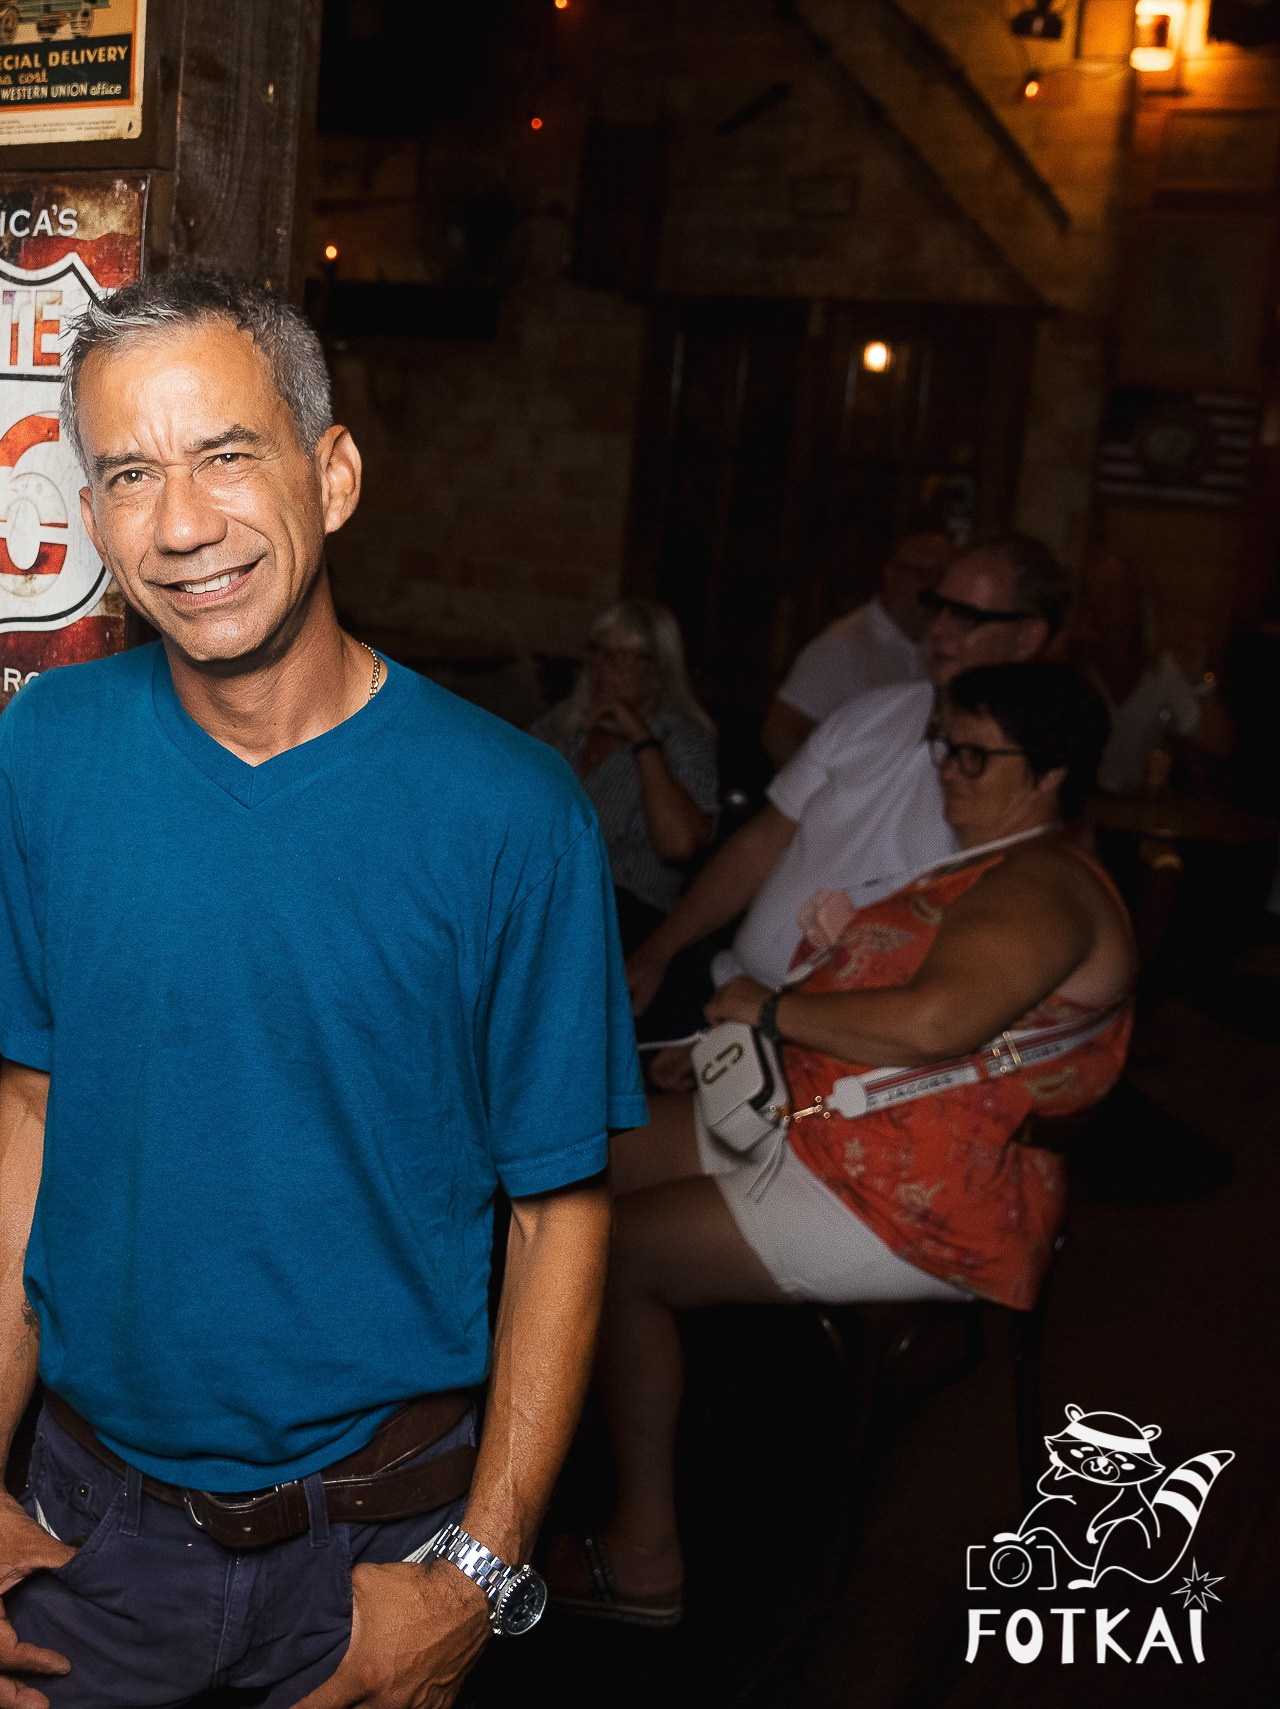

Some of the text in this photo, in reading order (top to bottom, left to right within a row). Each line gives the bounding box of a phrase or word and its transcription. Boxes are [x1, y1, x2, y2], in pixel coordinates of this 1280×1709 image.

[48, 45, 128, 67] DELIVERY
[0, 85, 48, 101] WESTERN
[50, 81, 88, 98] UNION
